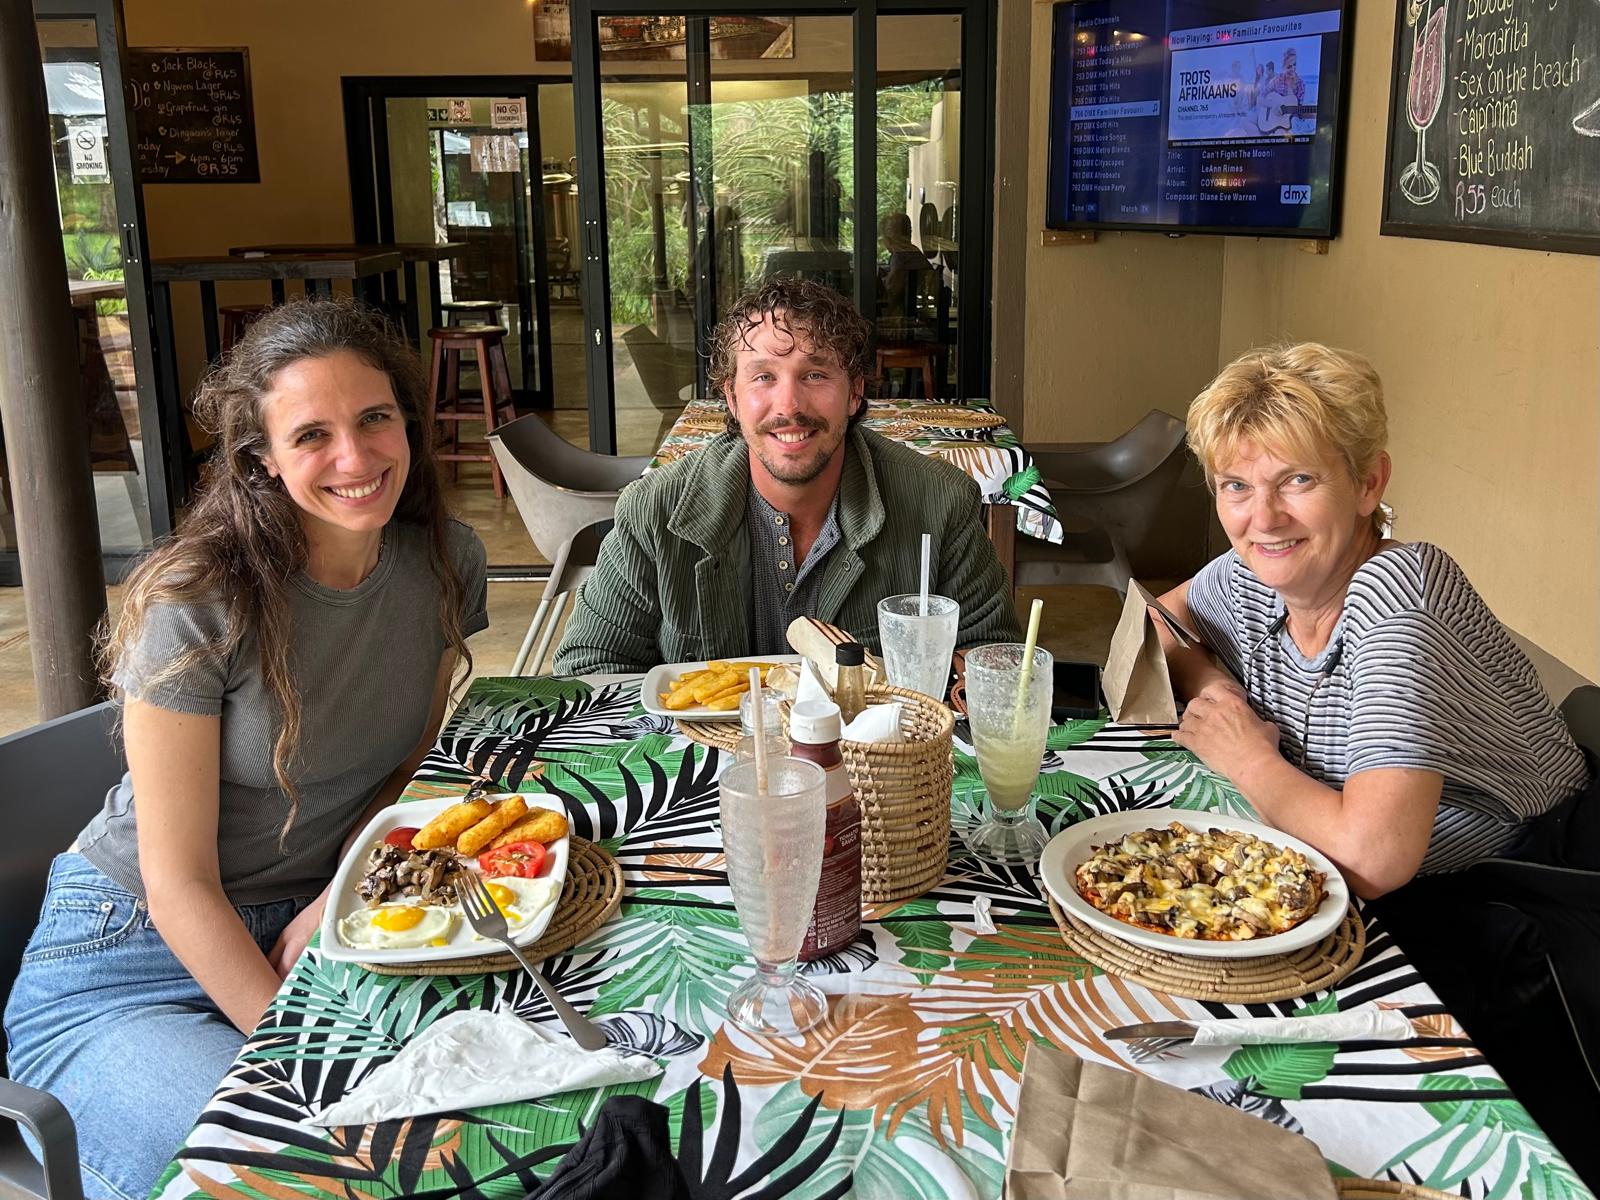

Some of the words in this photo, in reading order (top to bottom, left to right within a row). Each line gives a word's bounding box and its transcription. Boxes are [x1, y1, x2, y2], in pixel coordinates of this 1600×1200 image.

[1094, 16, 1120, 26] Channels
[1172, 36, 1185, 45] Now
[1186, 33, 1212, 44] Playing:
[1216, 30, 1232, 40] DMX
[1232, 27, 1260, 38] Familiar
[1262, 22, 1302, 35] Favourites
[162, 57, 183, 72] Jack
[187, 56, 217, 70] Black
[1086, 58, 1098, 66] DMX
[1488, 67, 1504, 94] on
[1506, 63, 1526, 94] the
[1533, 44, 1580, 91] beach
[1086, 72, 1097, 80] DMX
[1180, 69, 1210, 86] TROTS
[196, 80, 222, 96] Lager
[1086, 84, 1096, 92] DMX
[1178, 83, 1236, 102] AFRIKAANS
[1085, 96, 1096, 104] DMX
[214, 104, 228, 116] gin
[496, 106, 507, 114] NO
[1178, 105, 1198, 113] CHANNEL
[1084, 134, 1094, 142] DMX
[190, 154, 210, 164] 4pm
[221, 154, 244, 166] 6pm
[1202, 150, 1220, 159] Can't
[1220, 150, 1238, 160] Fight
[1239, 150, 1250, 158] The
[1488, 136, 1533, 177] Buddah
[1094, 158, 1124, 168] Cityscapes
[1223, 164, 1243, 172] Rimes
[1111, 183, 1126, 192] Party
[1200, 178, 1226, 187] COYOTE
[1228, 178, 1246, 187] UGLY
[1200, 192, 1218, 201] Diane
[1220, 192, 1232, 200] Eve
[1233, 192, 1256, 201] Warren
[1284, 187, 1308, 202] dmx
[1455, 180, 1486, 220] R55
[1491, 180, 1521, 209] each
[840, 828, 859, 842] TOMATO
[841, 834, 858, 847] SAUCE
